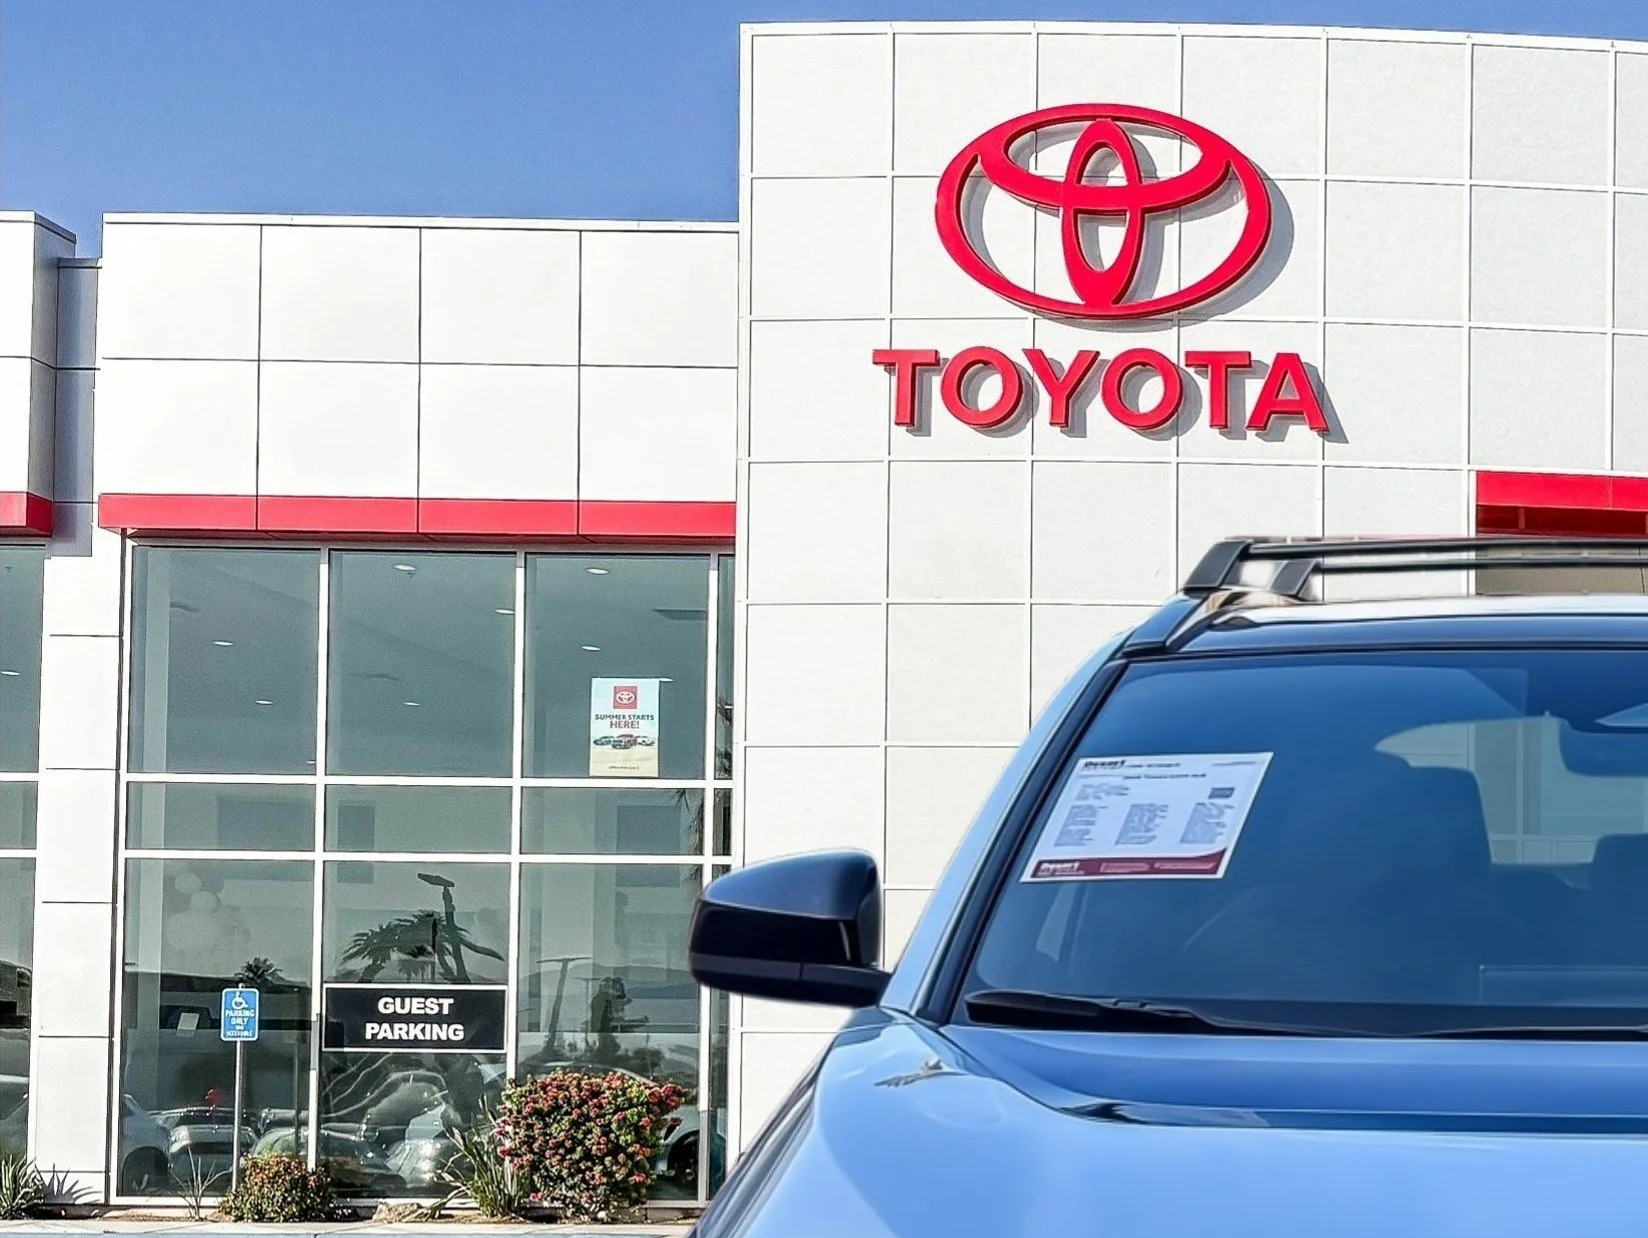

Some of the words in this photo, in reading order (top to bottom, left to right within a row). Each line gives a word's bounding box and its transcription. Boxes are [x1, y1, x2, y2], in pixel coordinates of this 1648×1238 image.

[872, 346, 1330, 434] TOYOTA
[610, 721, 640, 729] HERE!
[378, 997, 454, 1015] GUEST
[365, 1023, 465, 1041] PARKING
